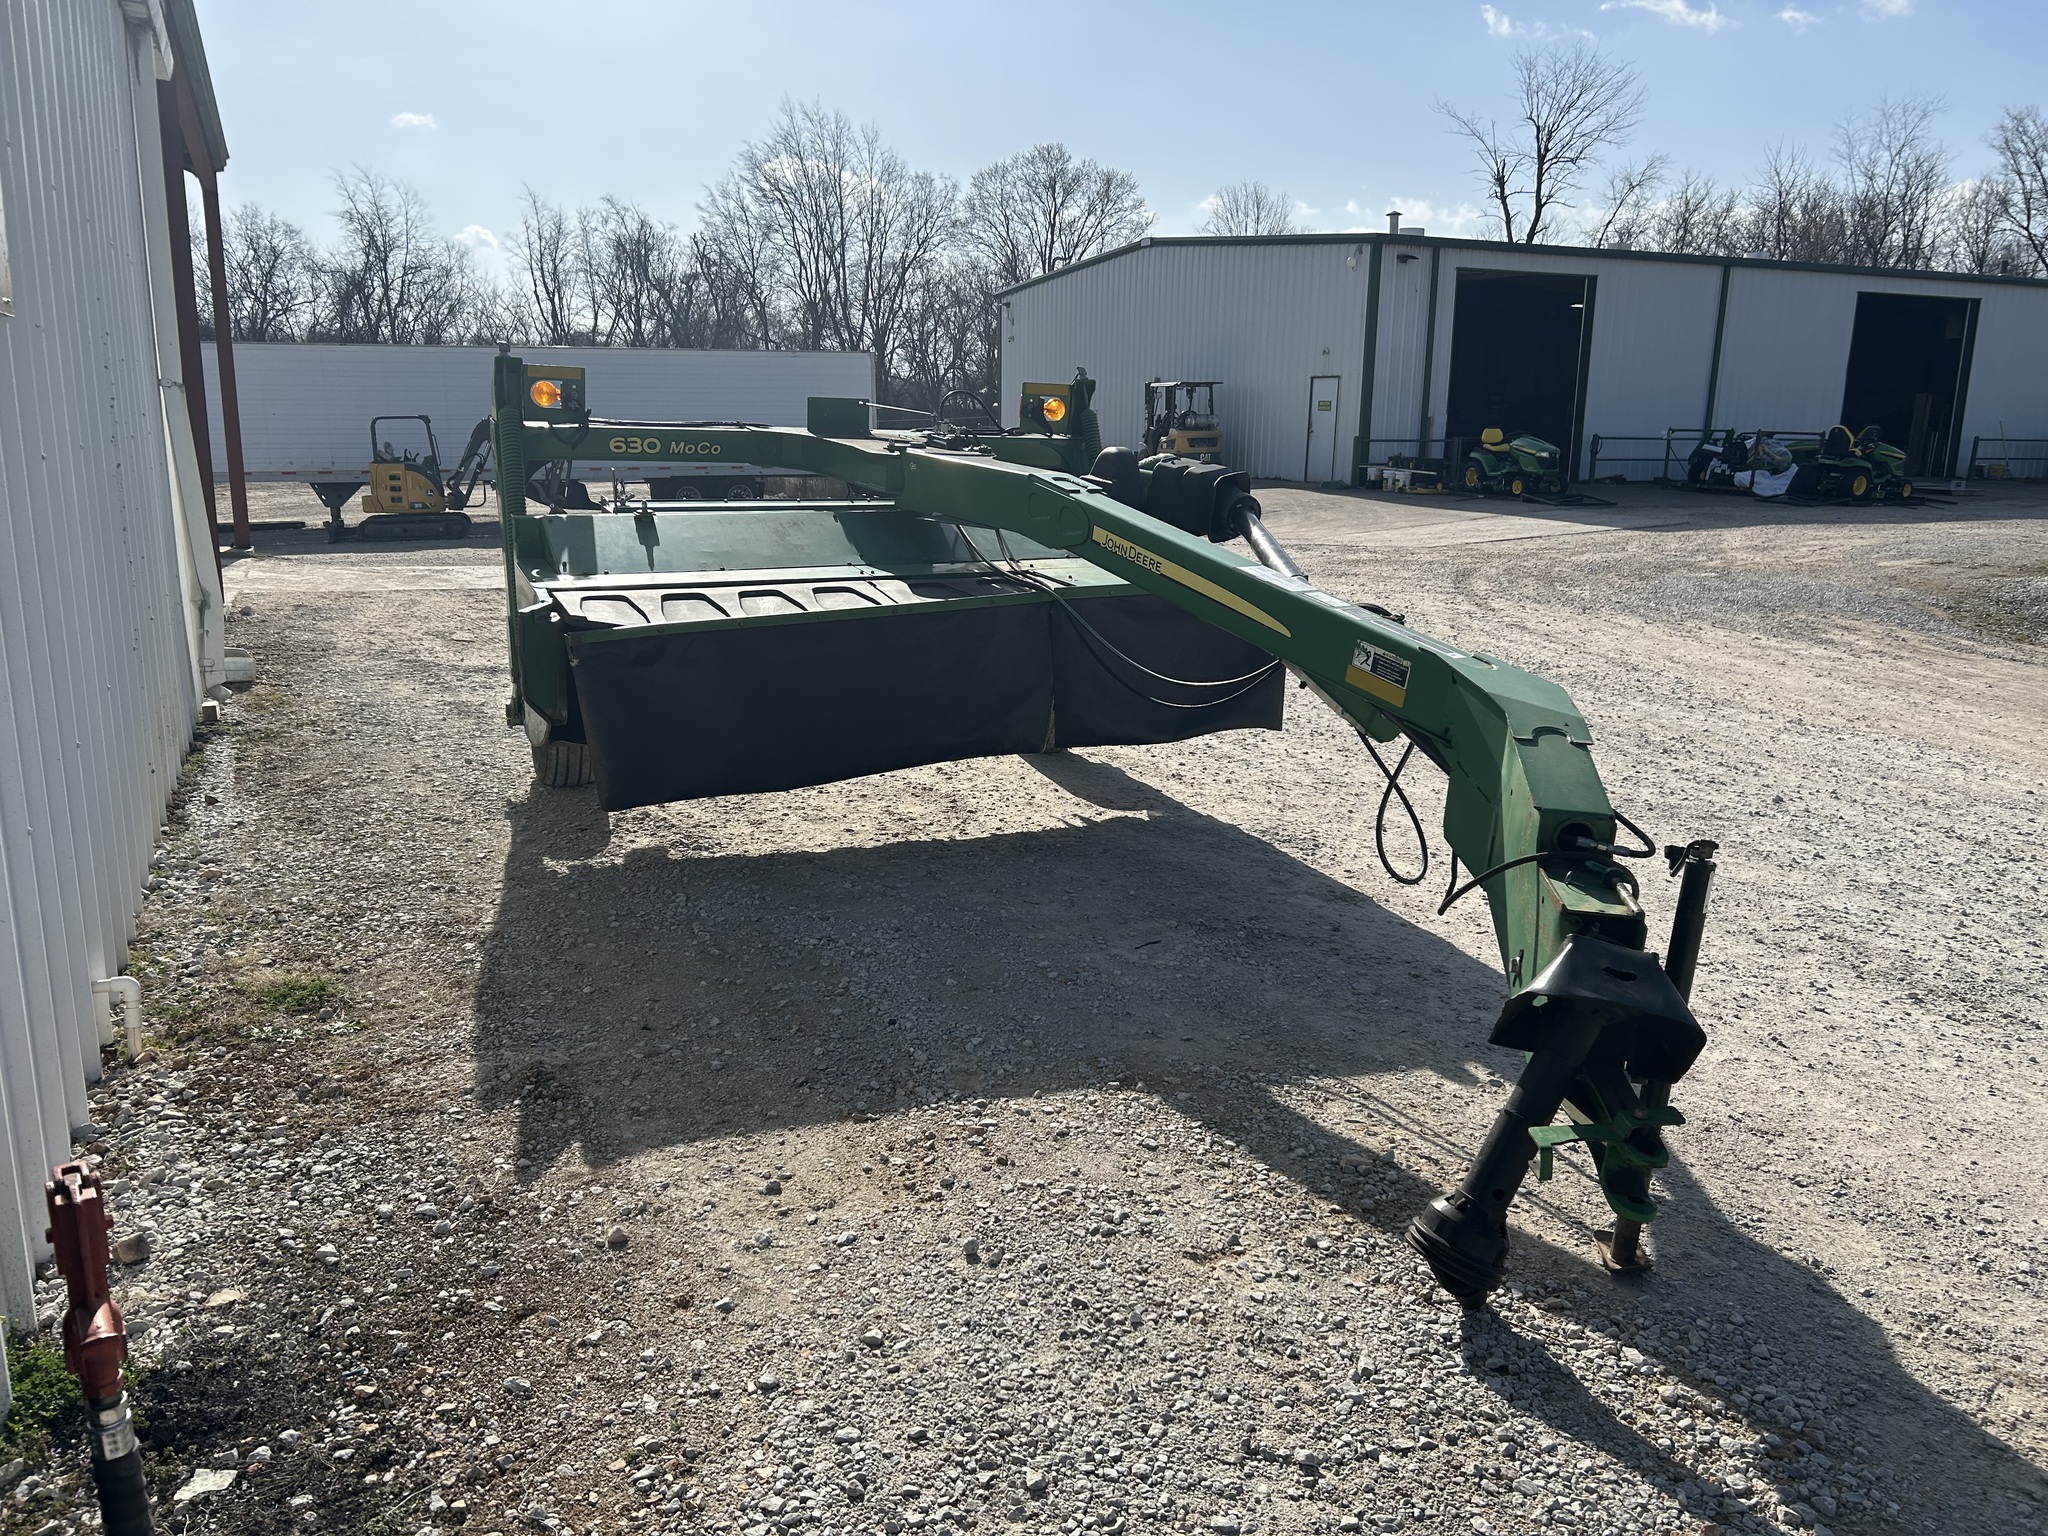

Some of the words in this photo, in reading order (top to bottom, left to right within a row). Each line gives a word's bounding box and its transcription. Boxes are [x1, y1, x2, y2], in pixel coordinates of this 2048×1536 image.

[609, 437, 661, 454] 630
[669, 441, 721, 455] MoCo
[1200, 453, 1211, 461] CAT
[1101, 534, 1128, 558] JOHN
[1128, 545, 1162, 573] DEERE
